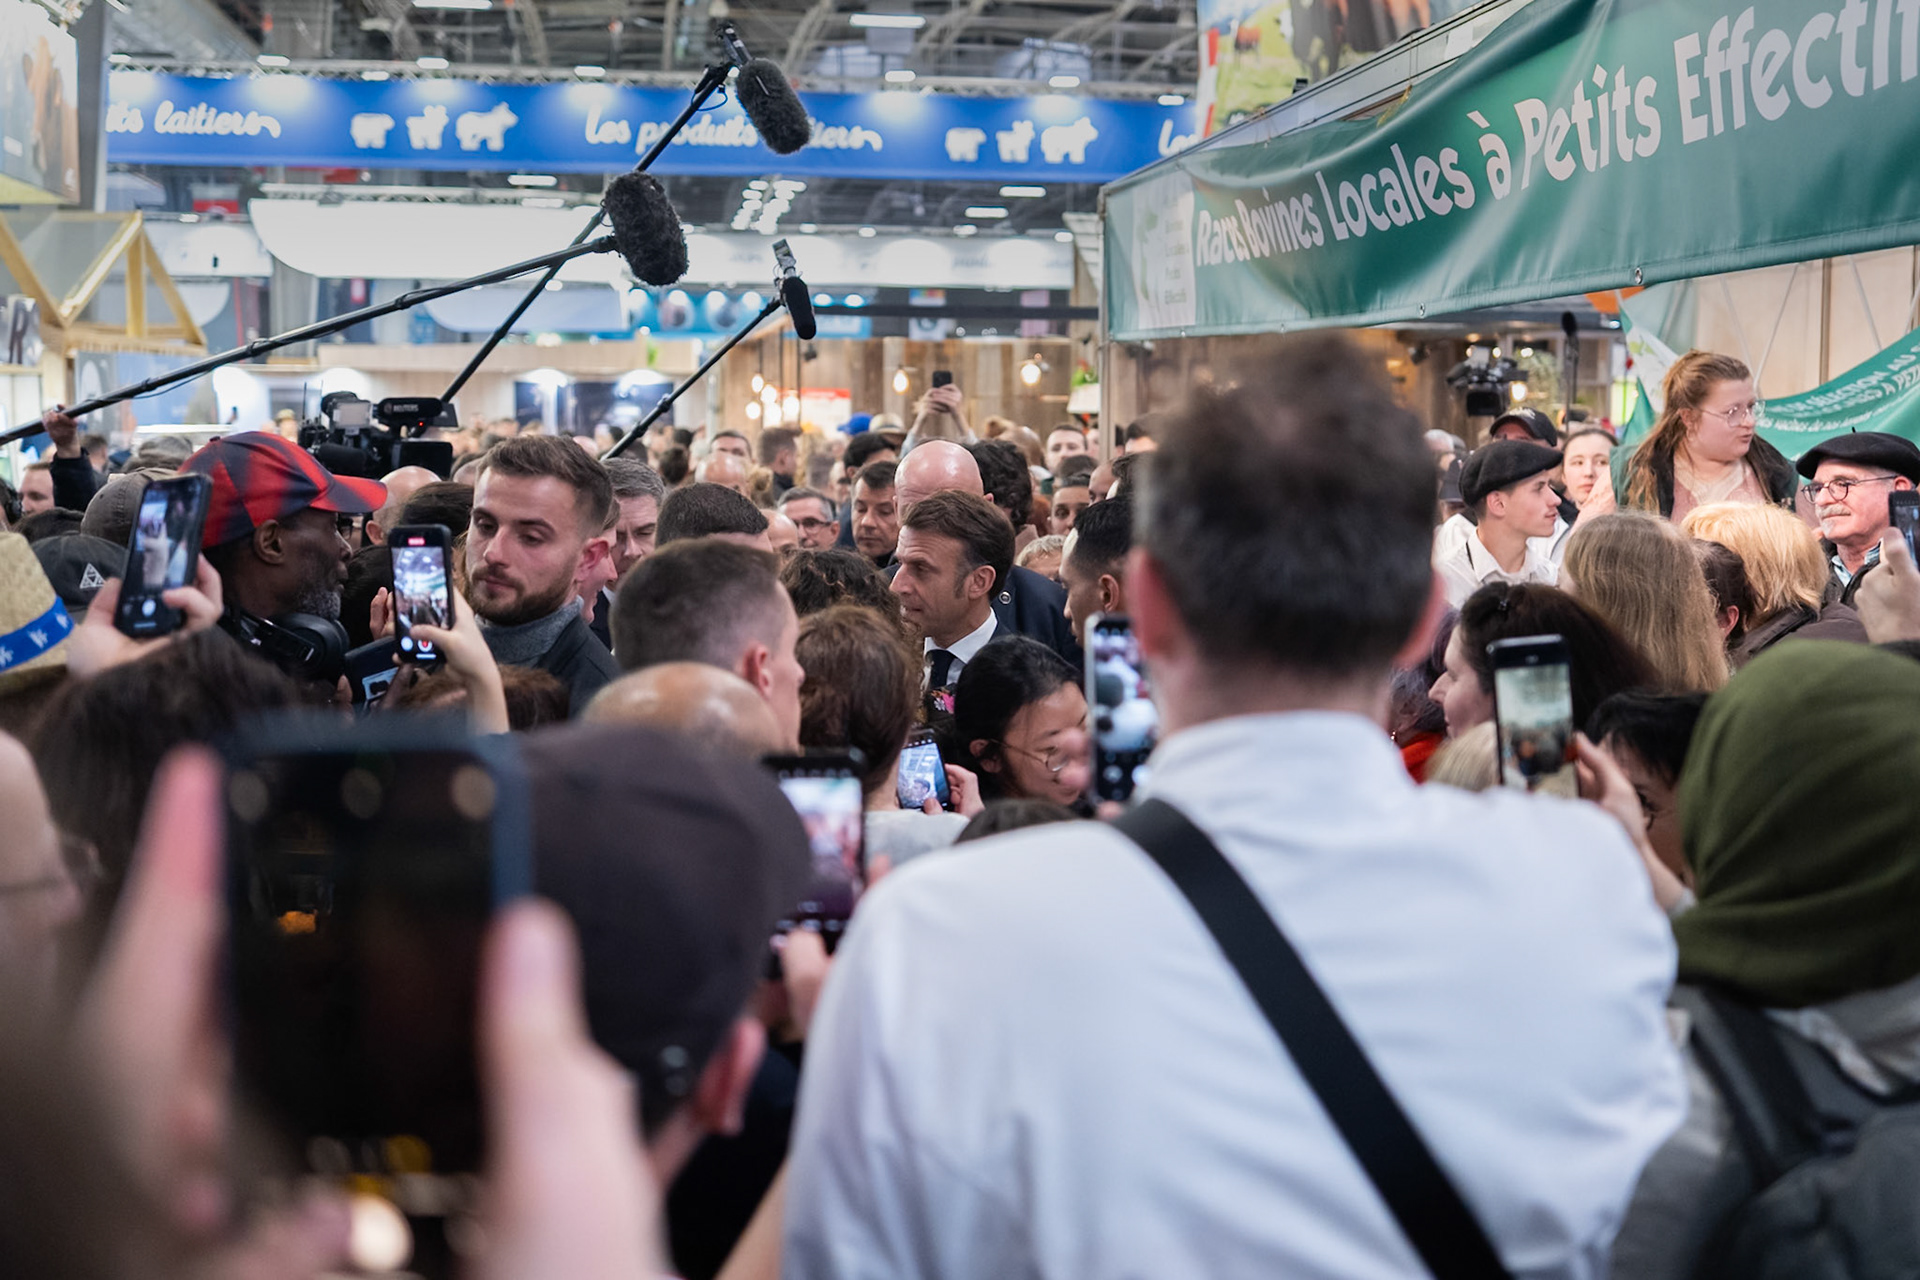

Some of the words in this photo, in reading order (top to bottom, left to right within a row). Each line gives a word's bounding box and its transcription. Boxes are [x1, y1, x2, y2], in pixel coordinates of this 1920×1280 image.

[1234, 186, 1325, 258] Bovines
[1315, 143, 1476, 241] Locales
[1466, 110, 1512, 200] à
[1513, 63, 1662, 190] Petits
